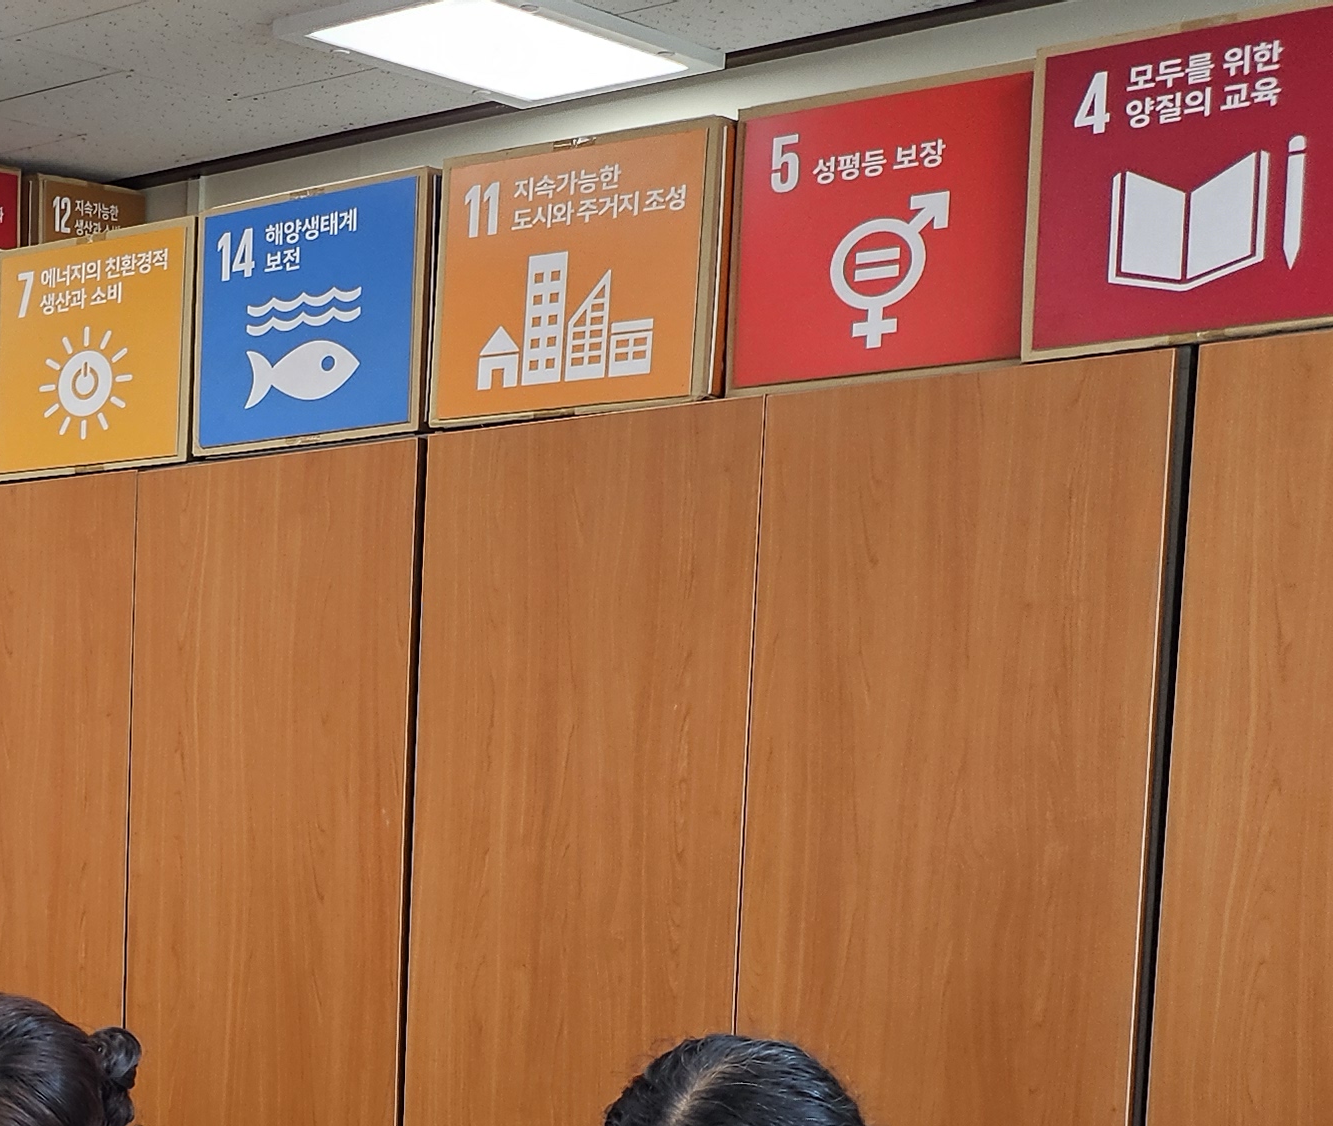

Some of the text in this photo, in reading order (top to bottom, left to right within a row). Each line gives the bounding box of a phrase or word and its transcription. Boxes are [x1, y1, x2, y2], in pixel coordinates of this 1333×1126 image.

[1124, 40, 1285, 95] 모두를 위한
[1073, 70, 1111, 135] 4
[1124, 76, 1283, 130] 양질의 교육
[513, 163, 622, 201] 지속가능한
[771, 133, 800, 195] 5
[812, 138, 946, 183] 성평등 보장
[52, 195, 72, 235] 12
[74, 199, 119, 222] 지속가능한
[264, 206, 359, 247] 해양생태계
[464, 179, 502, 240] 11
[510, 182, 689, 232] 도시와 주거지 조성
[39, 247, 169, 289] 에너지의 친환경적
[216, 227, 255, 283] 14
[264, 247, 301, 273] 보전
[17, 271, 35, 319] 7
[39, 282, 123, 316] 생산과 소비
